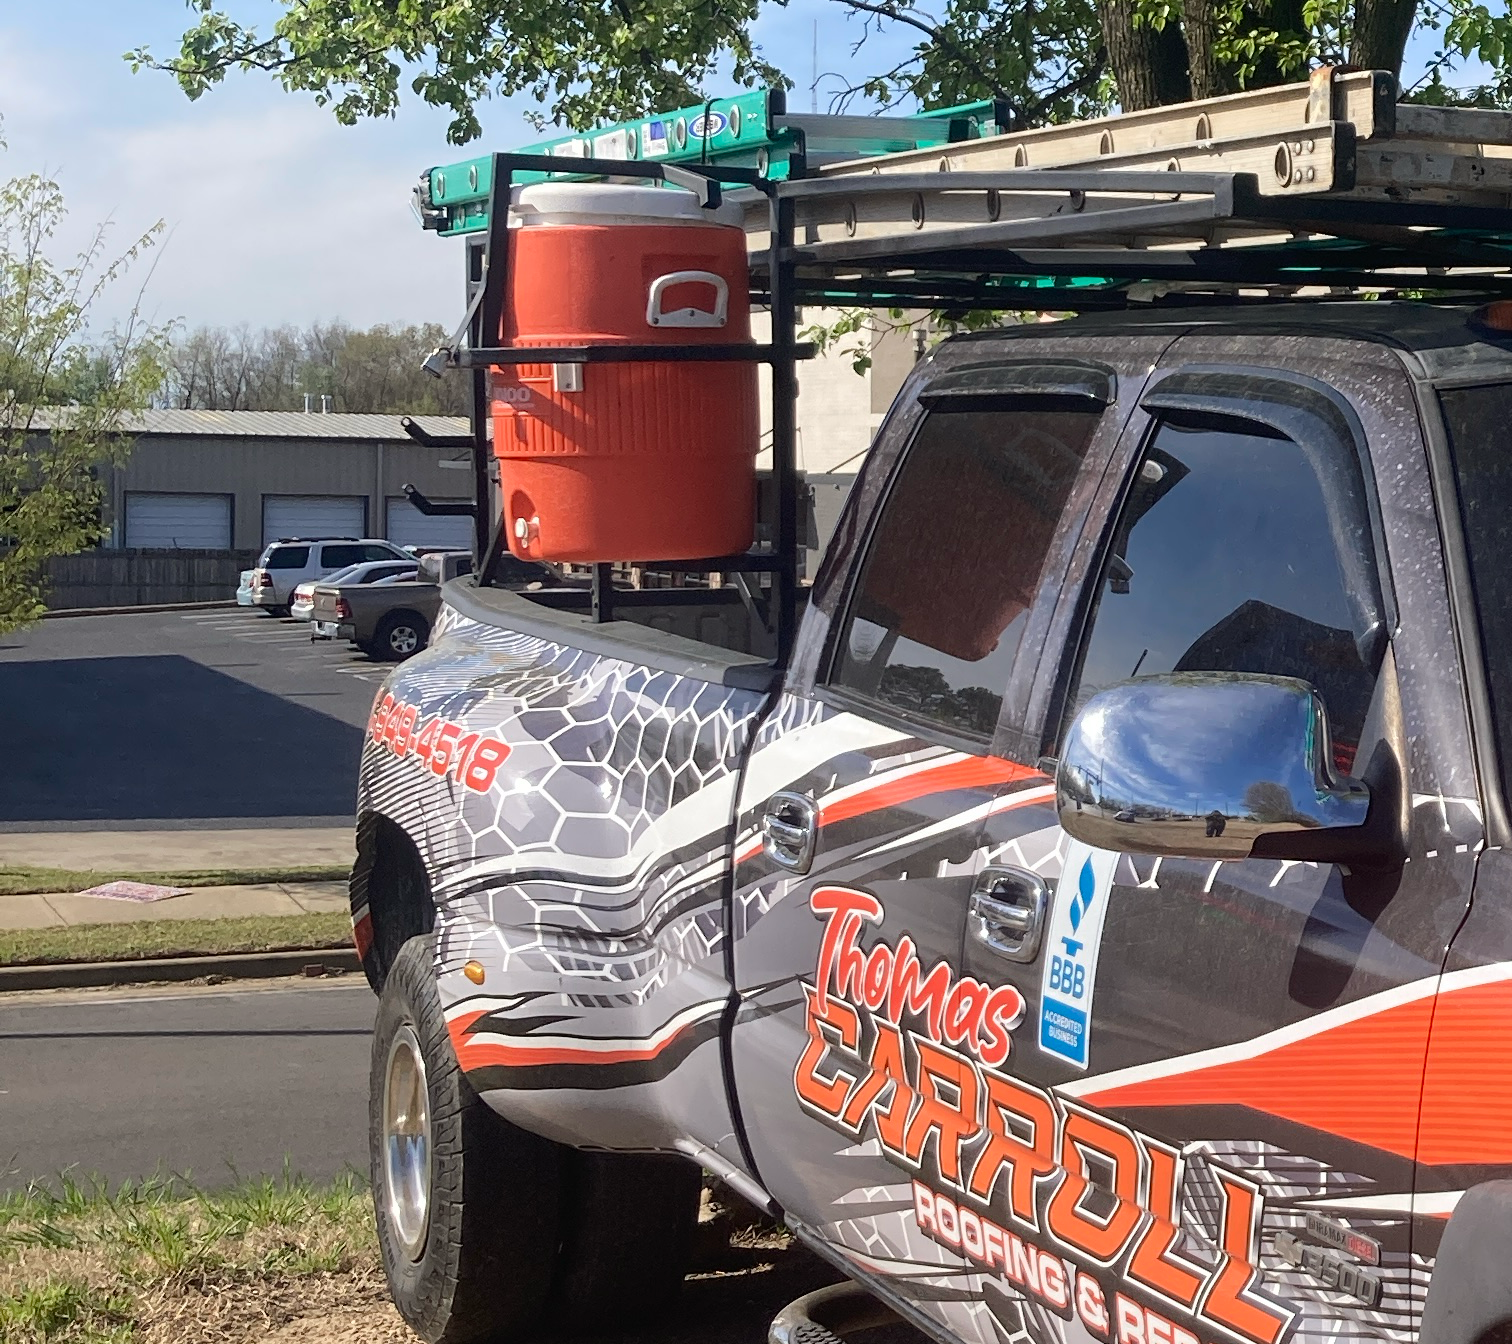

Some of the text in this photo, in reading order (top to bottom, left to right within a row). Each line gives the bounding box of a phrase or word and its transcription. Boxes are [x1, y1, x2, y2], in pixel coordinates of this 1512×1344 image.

[811, 886, 1028, 1067] Thomas
[1049, 954, 1086, 999] BBB
[1044, 1009, 1083, 1035] ACCREDITED
[1048, 1025, 1078, 1047] BUSINESS
[1308, 1217, 1346, 1244] DURAMAX
[912, 1179, 1072, 1310] ROOFING
[1075, 1270, 1110, 1336] &
[1301, 1244, 1380, 1296] 3500
